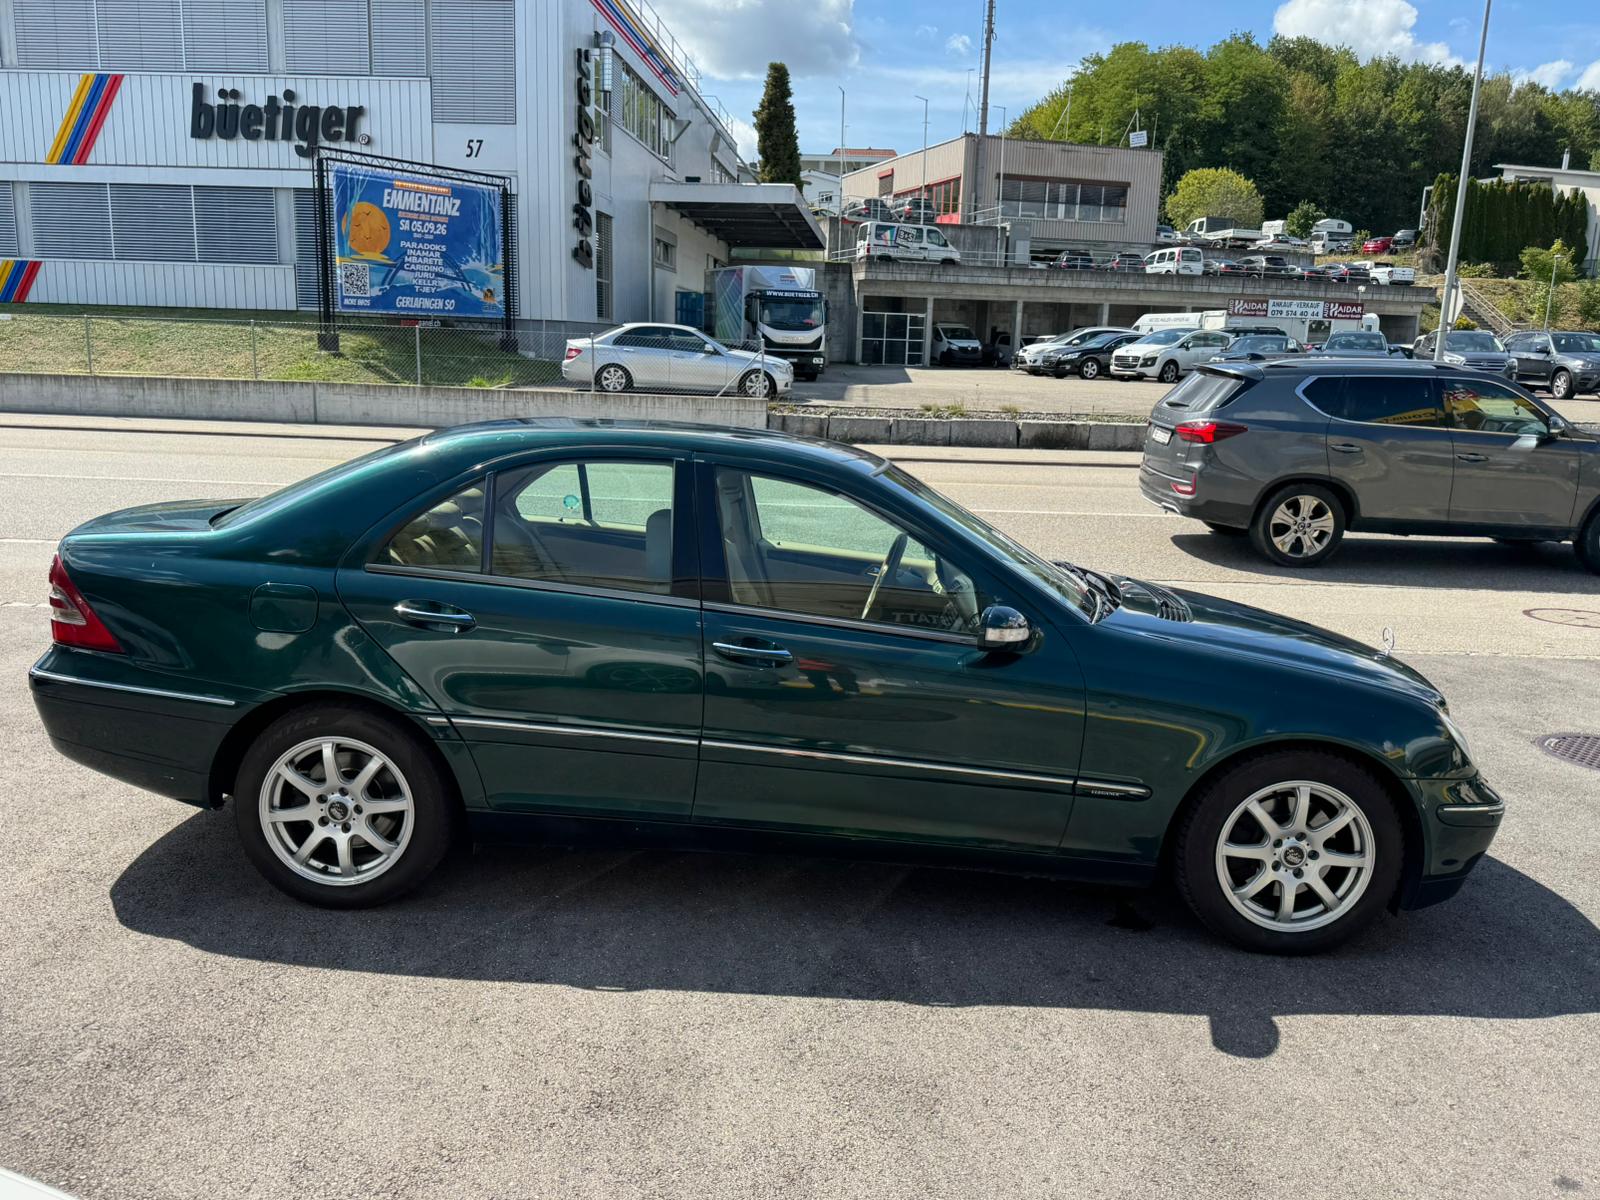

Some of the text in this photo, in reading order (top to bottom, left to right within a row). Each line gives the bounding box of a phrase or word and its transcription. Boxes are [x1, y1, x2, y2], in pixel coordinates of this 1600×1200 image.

[190, 82, 365, 158] büetiger
[466, 139, 484, 158] 57
[572, 48, 594, 269] büetiger
[383, 188, 461, 216] EMMENTANZ
[400, 219, 447, 235] SA 05.09.26
[400, 241, 446, 251] PARADOKS
[404, 256, 443, 265] MBARETE
[407, 249, 440, 258] INAMAR
[404, 264, 444, 273] CARIDINO
[396, 296, 455, 310] GERLAFINGEN SO
[1285, 309, 1298, 317] 574
